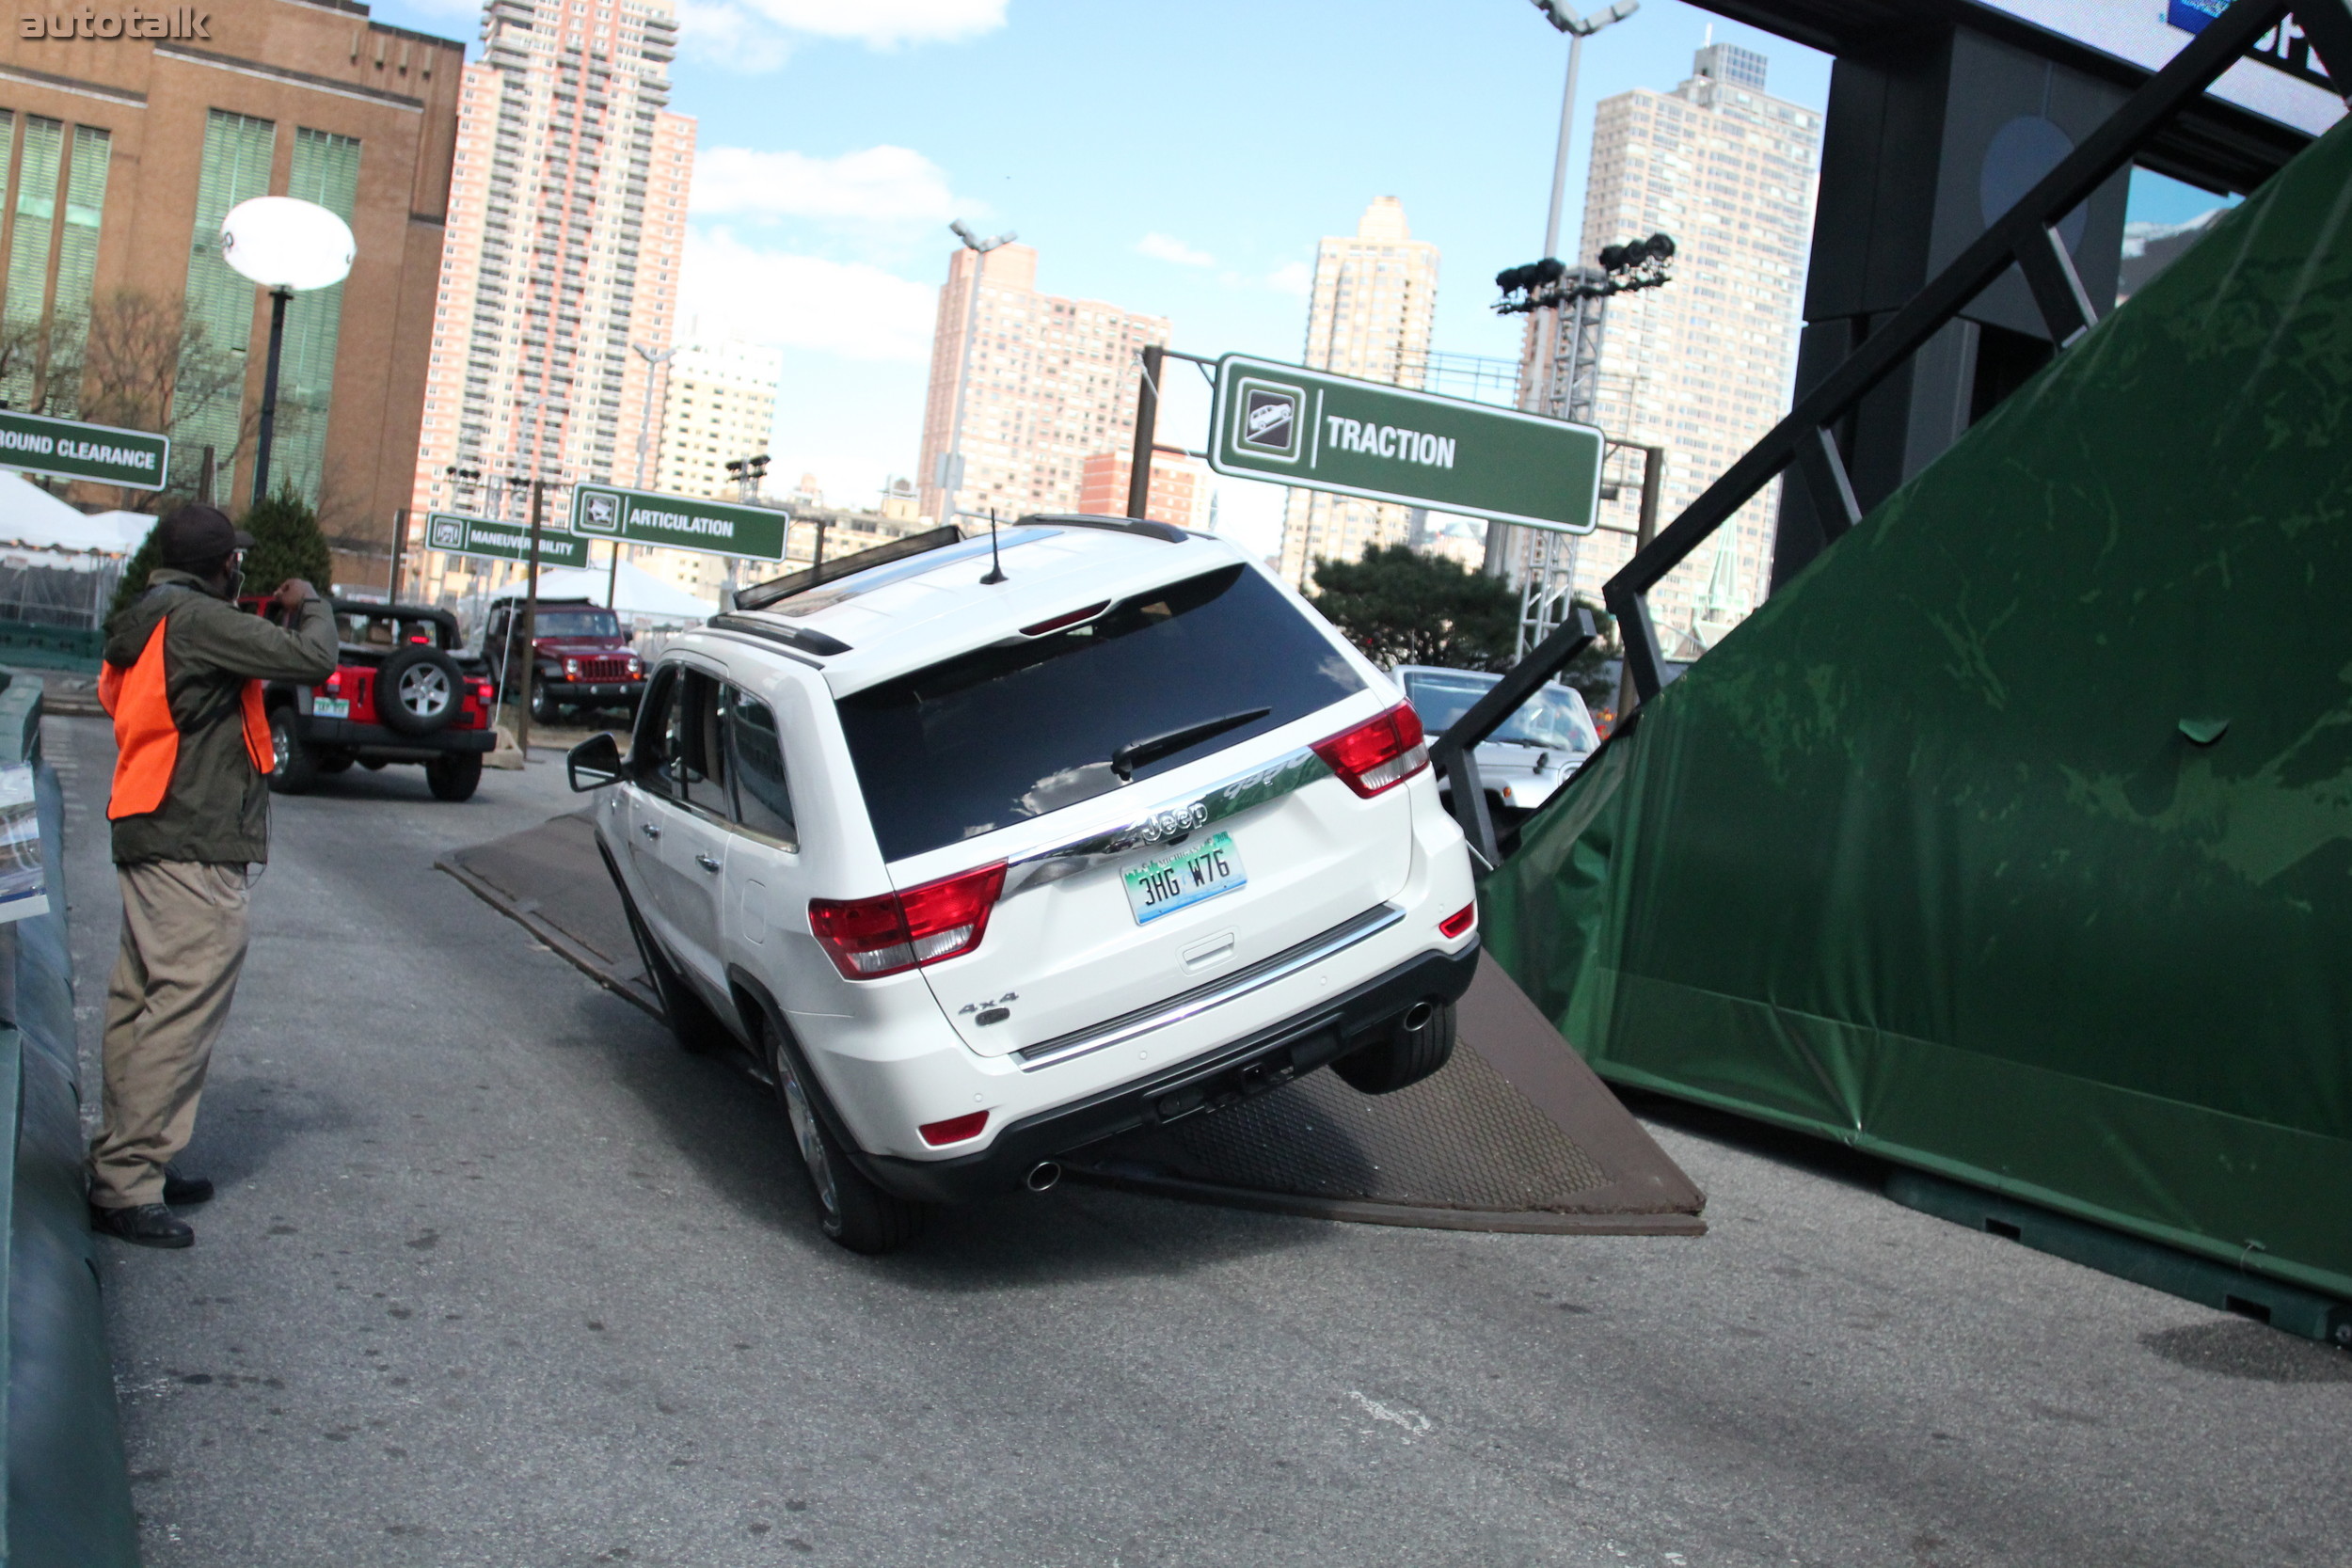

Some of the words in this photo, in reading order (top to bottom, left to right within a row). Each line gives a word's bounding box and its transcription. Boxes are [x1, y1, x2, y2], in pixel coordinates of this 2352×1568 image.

[56, 438, 156, 470] CLEARANCE
[1327, 415, 1456, 469] TRACTION
[629, 508, 735, 538] ARTICULATION
[470, 530, 573, 556] MANEUVERBILITY
[1141, 802, 1208, 845] Jeep
[1138, 866, 1180, 907] 3HG
[1187, 848, 1231, 888] W76
